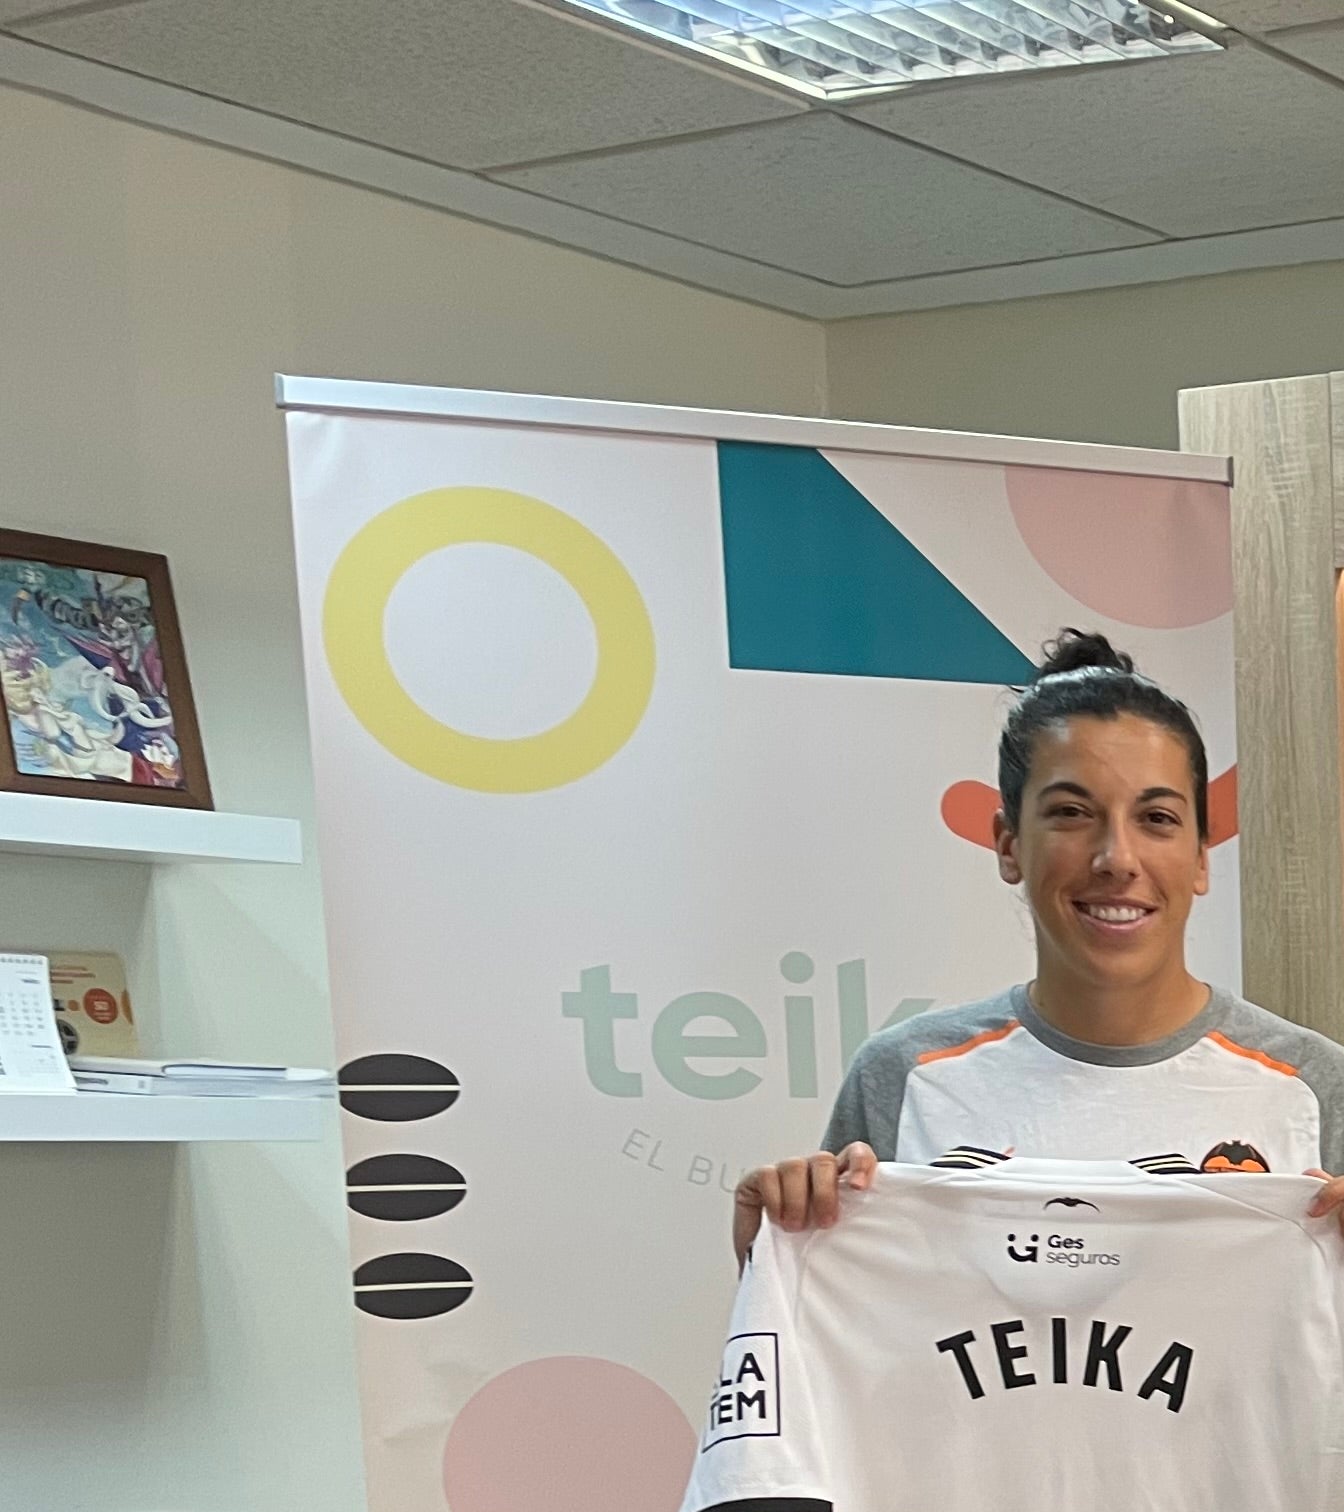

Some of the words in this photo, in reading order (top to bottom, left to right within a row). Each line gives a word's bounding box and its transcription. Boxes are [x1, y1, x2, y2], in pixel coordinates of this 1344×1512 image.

[621, 1128, 664, 1172] EL
[1047, 1234, 1085, 1250] Ges
[1046, 1251, 1121, 1269] seguros
[935, 1317, 1195, 1414] TEIKA
